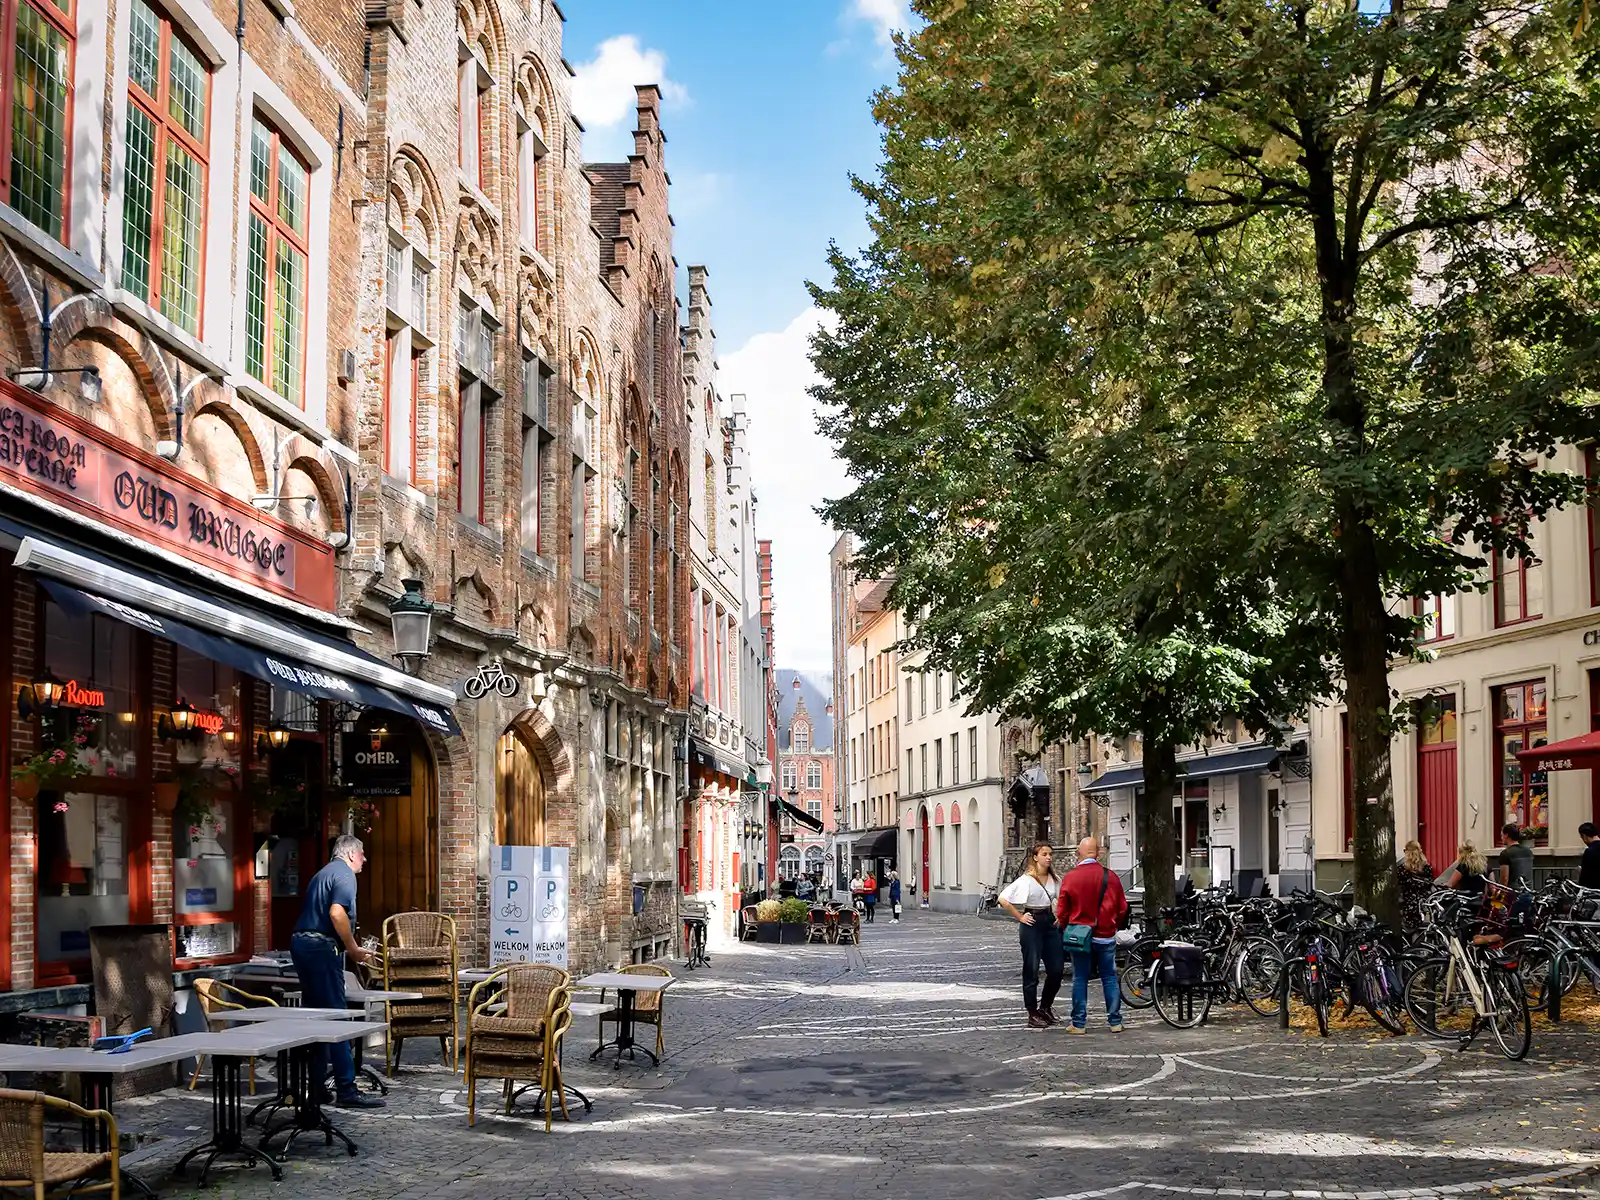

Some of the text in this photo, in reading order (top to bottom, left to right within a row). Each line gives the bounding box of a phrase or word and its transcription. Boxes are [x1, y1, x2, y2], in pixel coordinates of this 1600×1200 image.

[114, 471, 286, 576] OUD BRUGGE
[266, 657, 297, 683] OUD
[192, 707, 224, 735] rugge
[355, 752, 400, 765] OMER.
[507, 880, 518, 899] P
[547, 880, 556, 900] P
[493, 941, 529, 951] WELKOM
[536, 942, 565, 951] WELKOM
